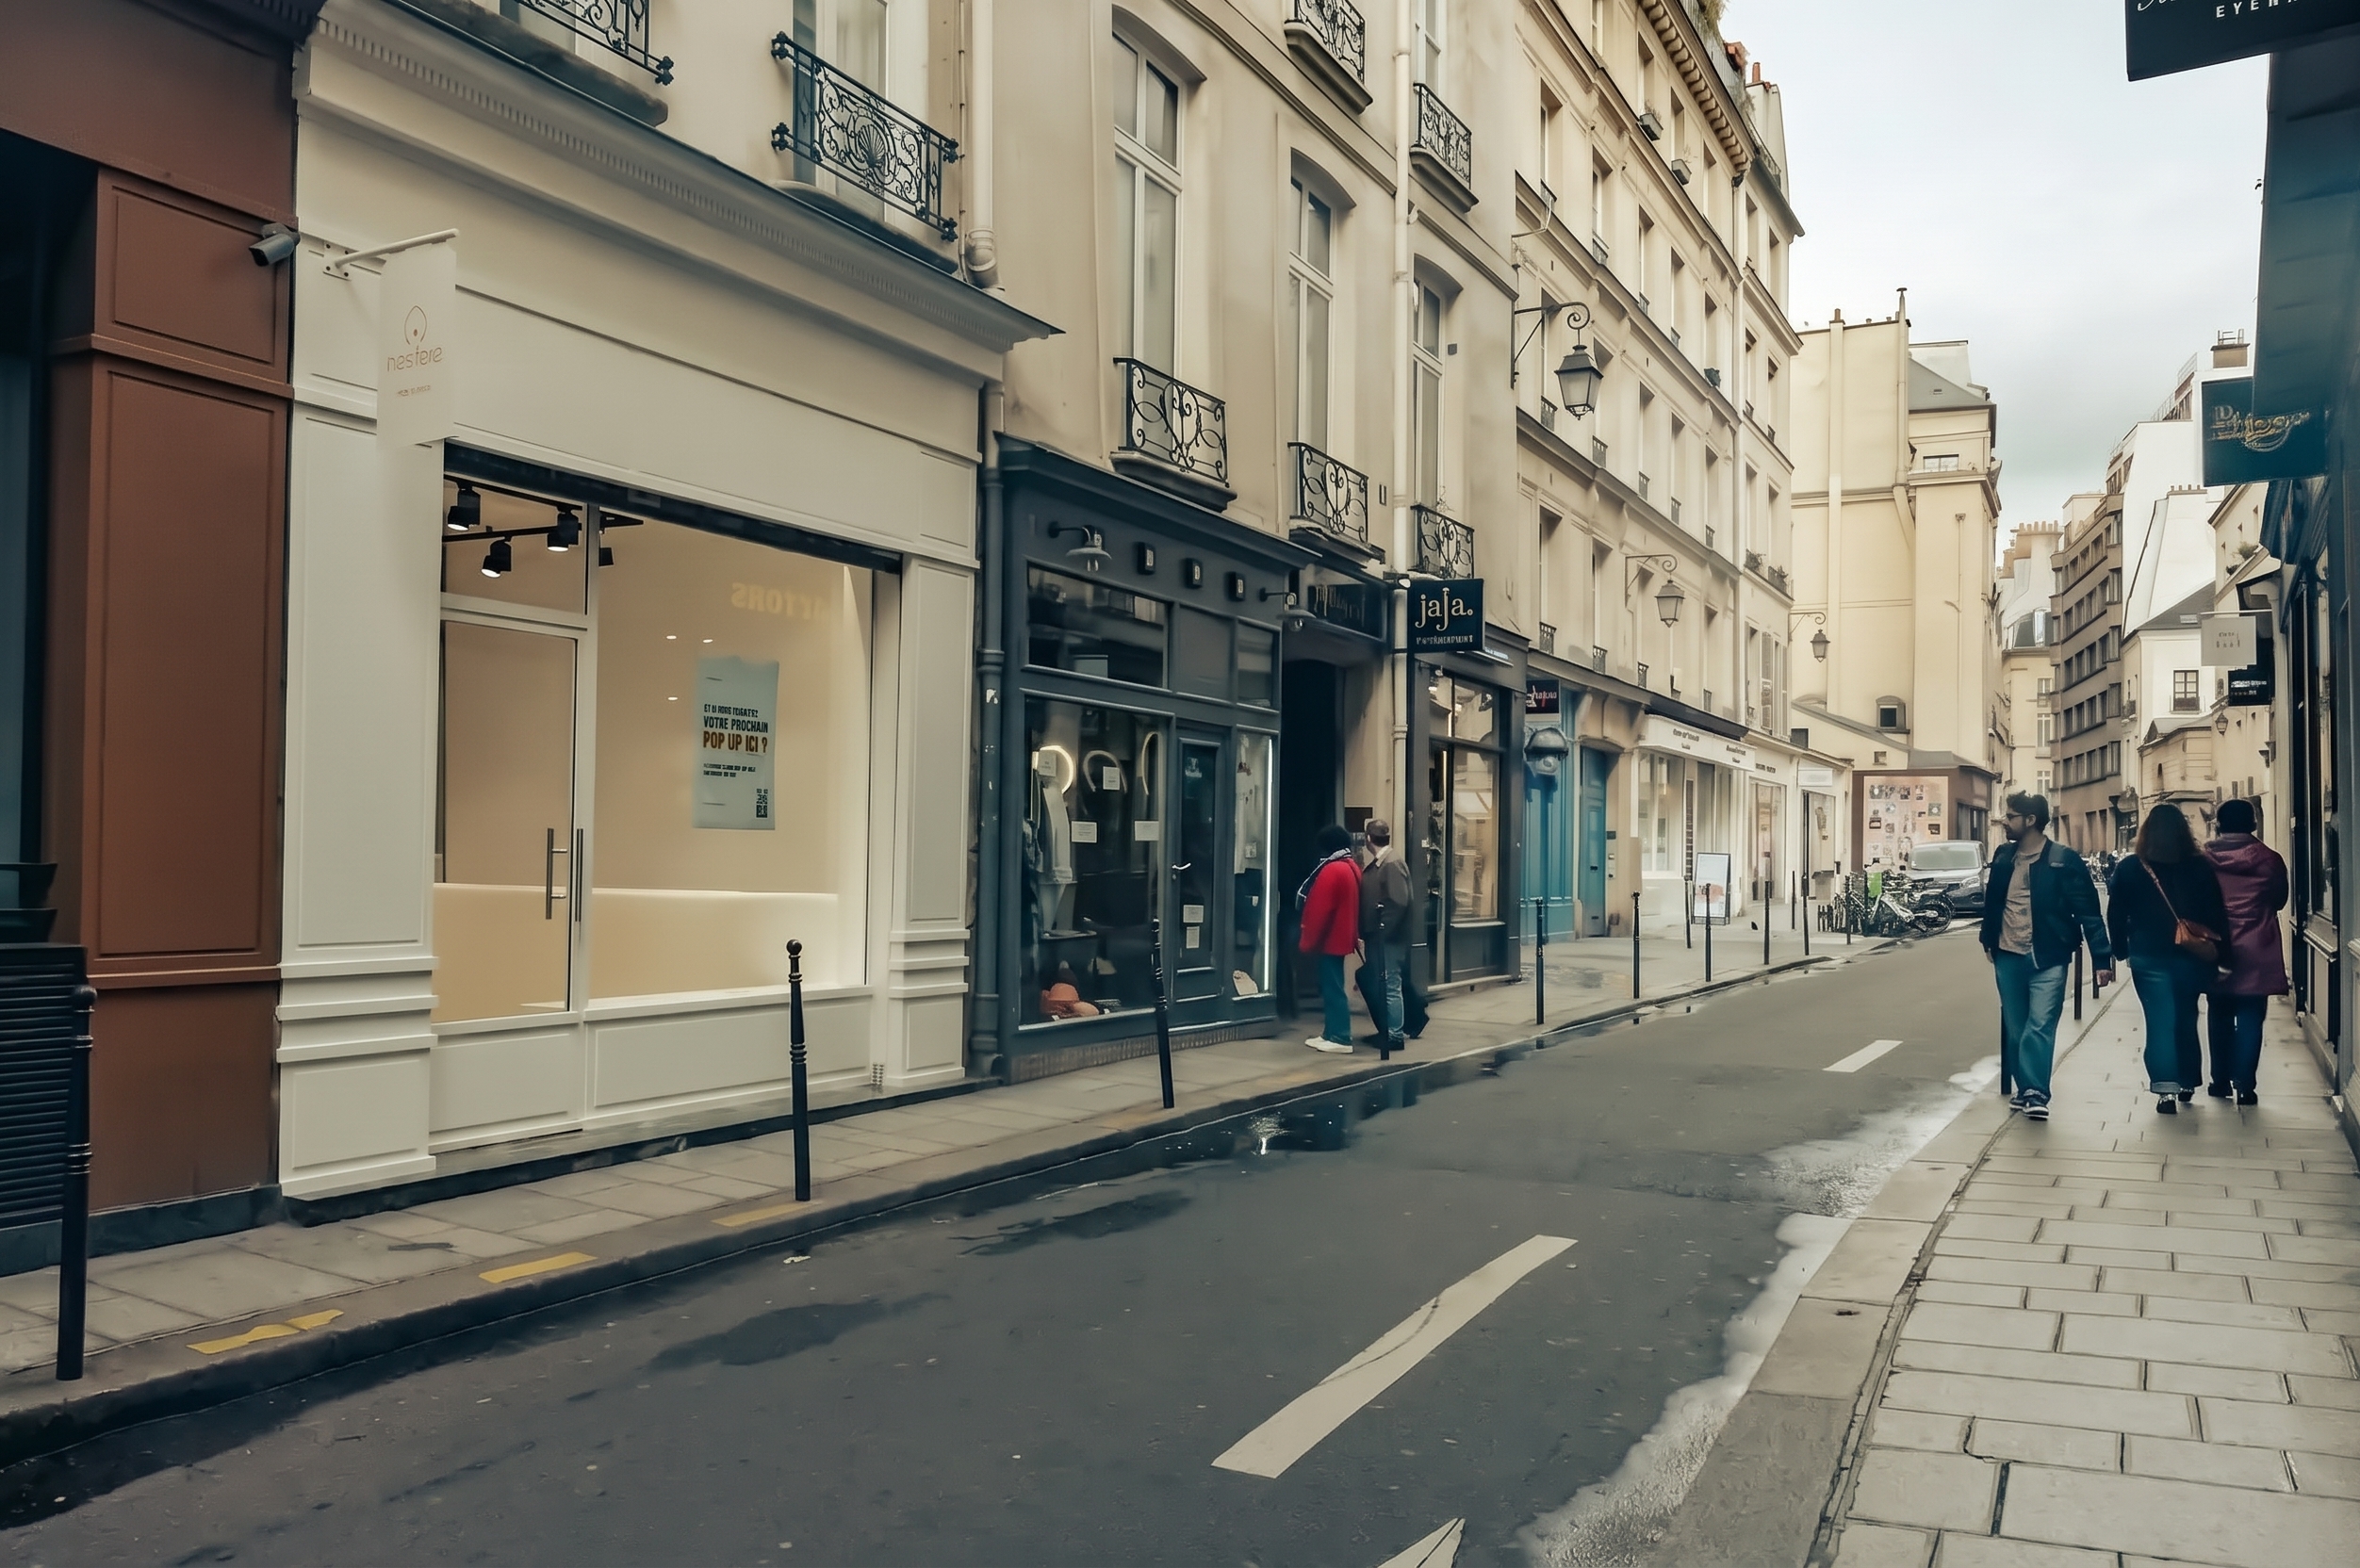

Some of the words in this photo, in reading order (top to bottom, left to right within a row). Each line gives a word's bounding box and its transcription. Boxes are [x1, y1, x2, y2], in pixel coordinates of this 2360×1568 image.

[703, 715, 729, 729] VOTRE
[730, 719, 768, 733] PROCHAIN
[703, 730, 725, 749] POP
[728, 733, 743, 751] UP
[745, 735, 759, 753] ICI
[762, 737, 768, 753] ?
